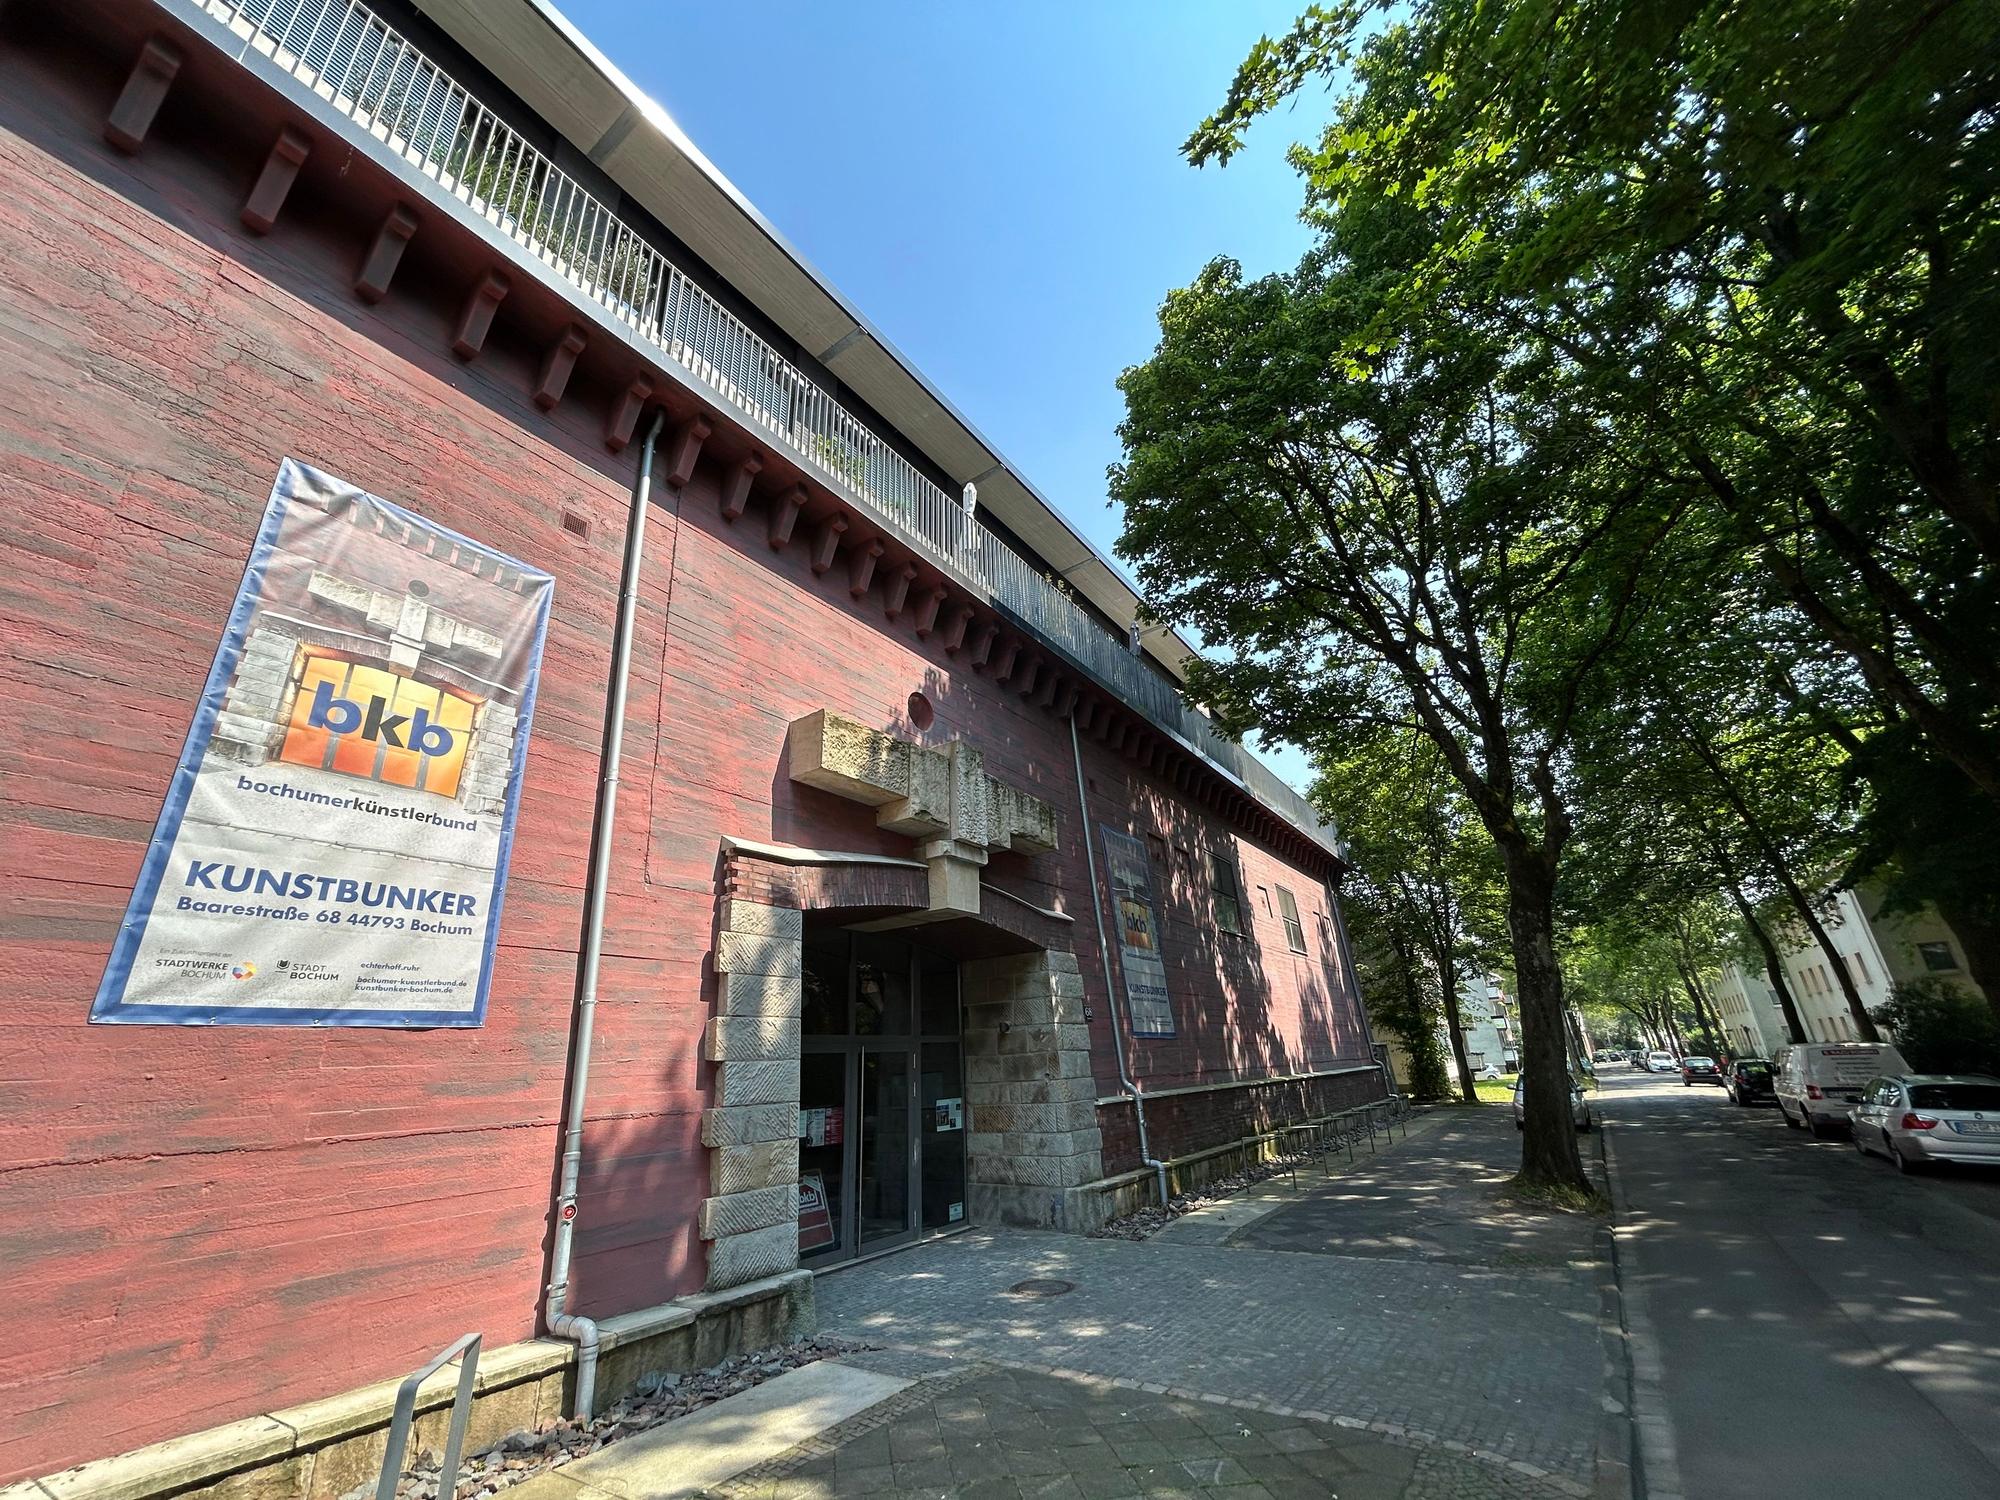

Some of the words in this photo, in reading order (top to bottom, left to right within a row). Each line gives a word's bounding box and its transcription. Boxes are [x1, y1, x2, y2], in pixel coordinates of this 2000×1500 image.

[308, 680, 454, 757] bkb
[237, 776, 477, 831] bochumerkünstlerbund
[185, 861, 477, 917] KUNSTBUNKER
[176, 896, 309, 921] Baarestraße
[316, 910, 341, 924] 68
[347, 913, 405, 929] 44793
[410, 919, 473, 935] Bochum
[155, 959, 229, 970] STADTWERKE
[181, 969, 226, 979] BOCHUM
[289, 971, 339, 981] BOCHUM
[292, 963, 327, 972] STADT
